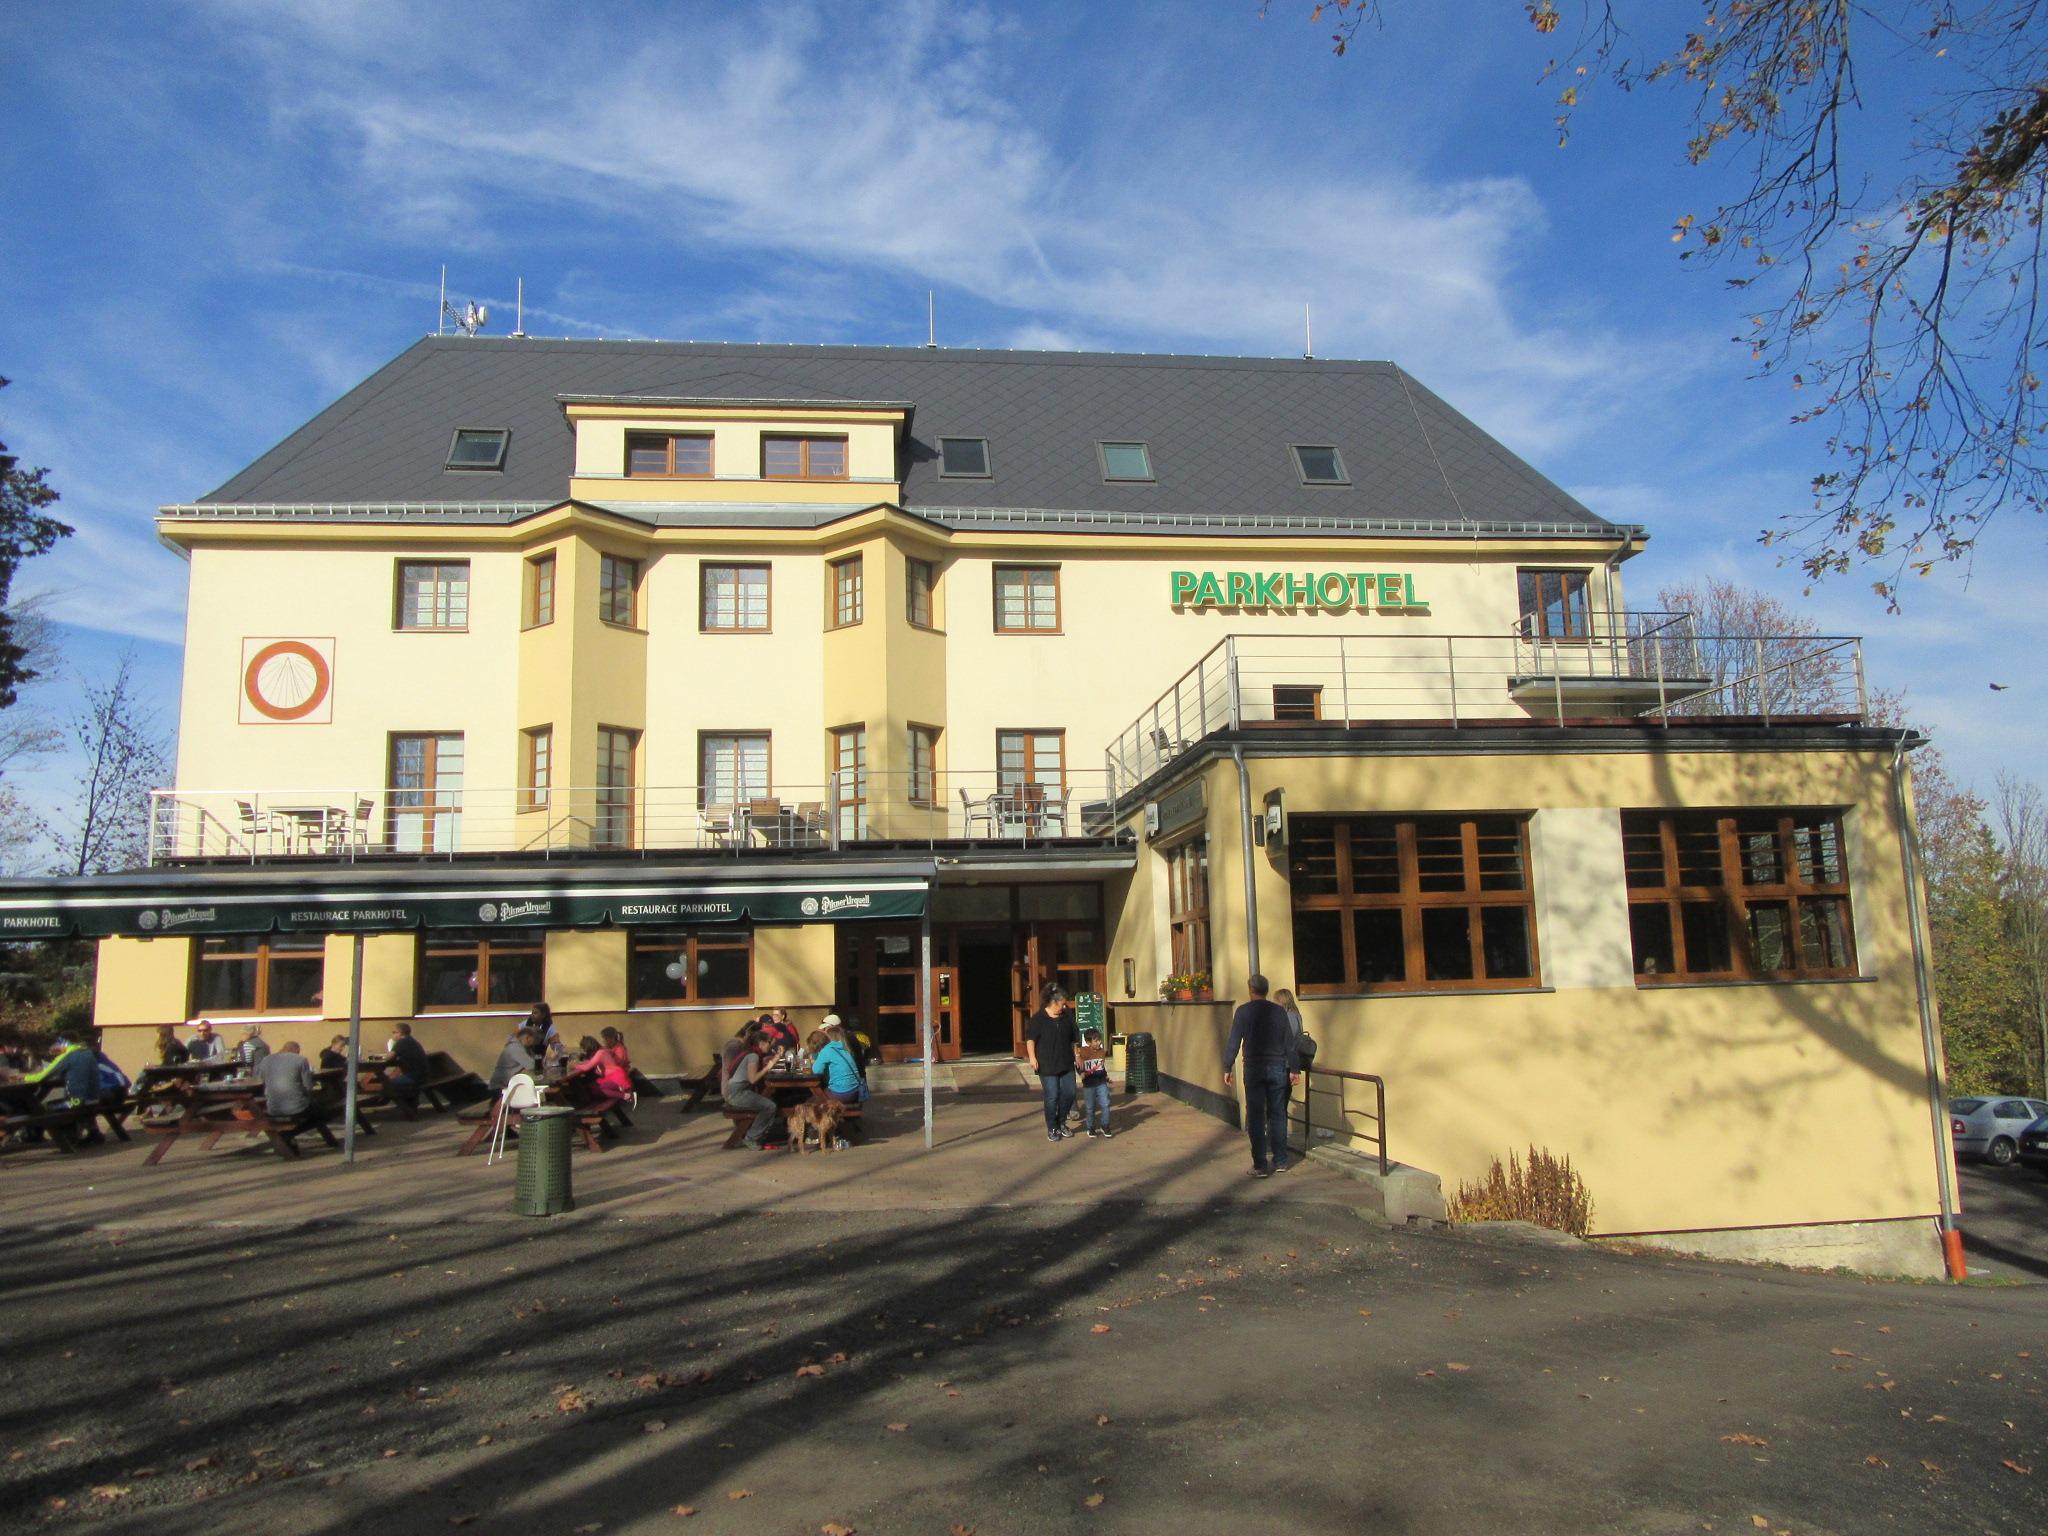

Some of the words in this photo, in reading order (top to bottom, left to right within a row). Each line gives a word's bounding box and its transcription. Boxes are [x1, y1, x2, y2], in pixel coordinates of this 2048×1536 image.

[1170, 571, 1430, 607] PARKHOTEL
[621, 904, 677, 915] RESTAURACE
[680, 903, 732, 913] PARKHOTEL
[822, 896, 847, 915] Pilsner
[845, 894, 871, 908] Urquell
[290, 910, 350, 921] RESTAURACE
[353, 909, 408, 920] PARKHOTEL
[3, 917, 61, 928] PARKHOTEL
